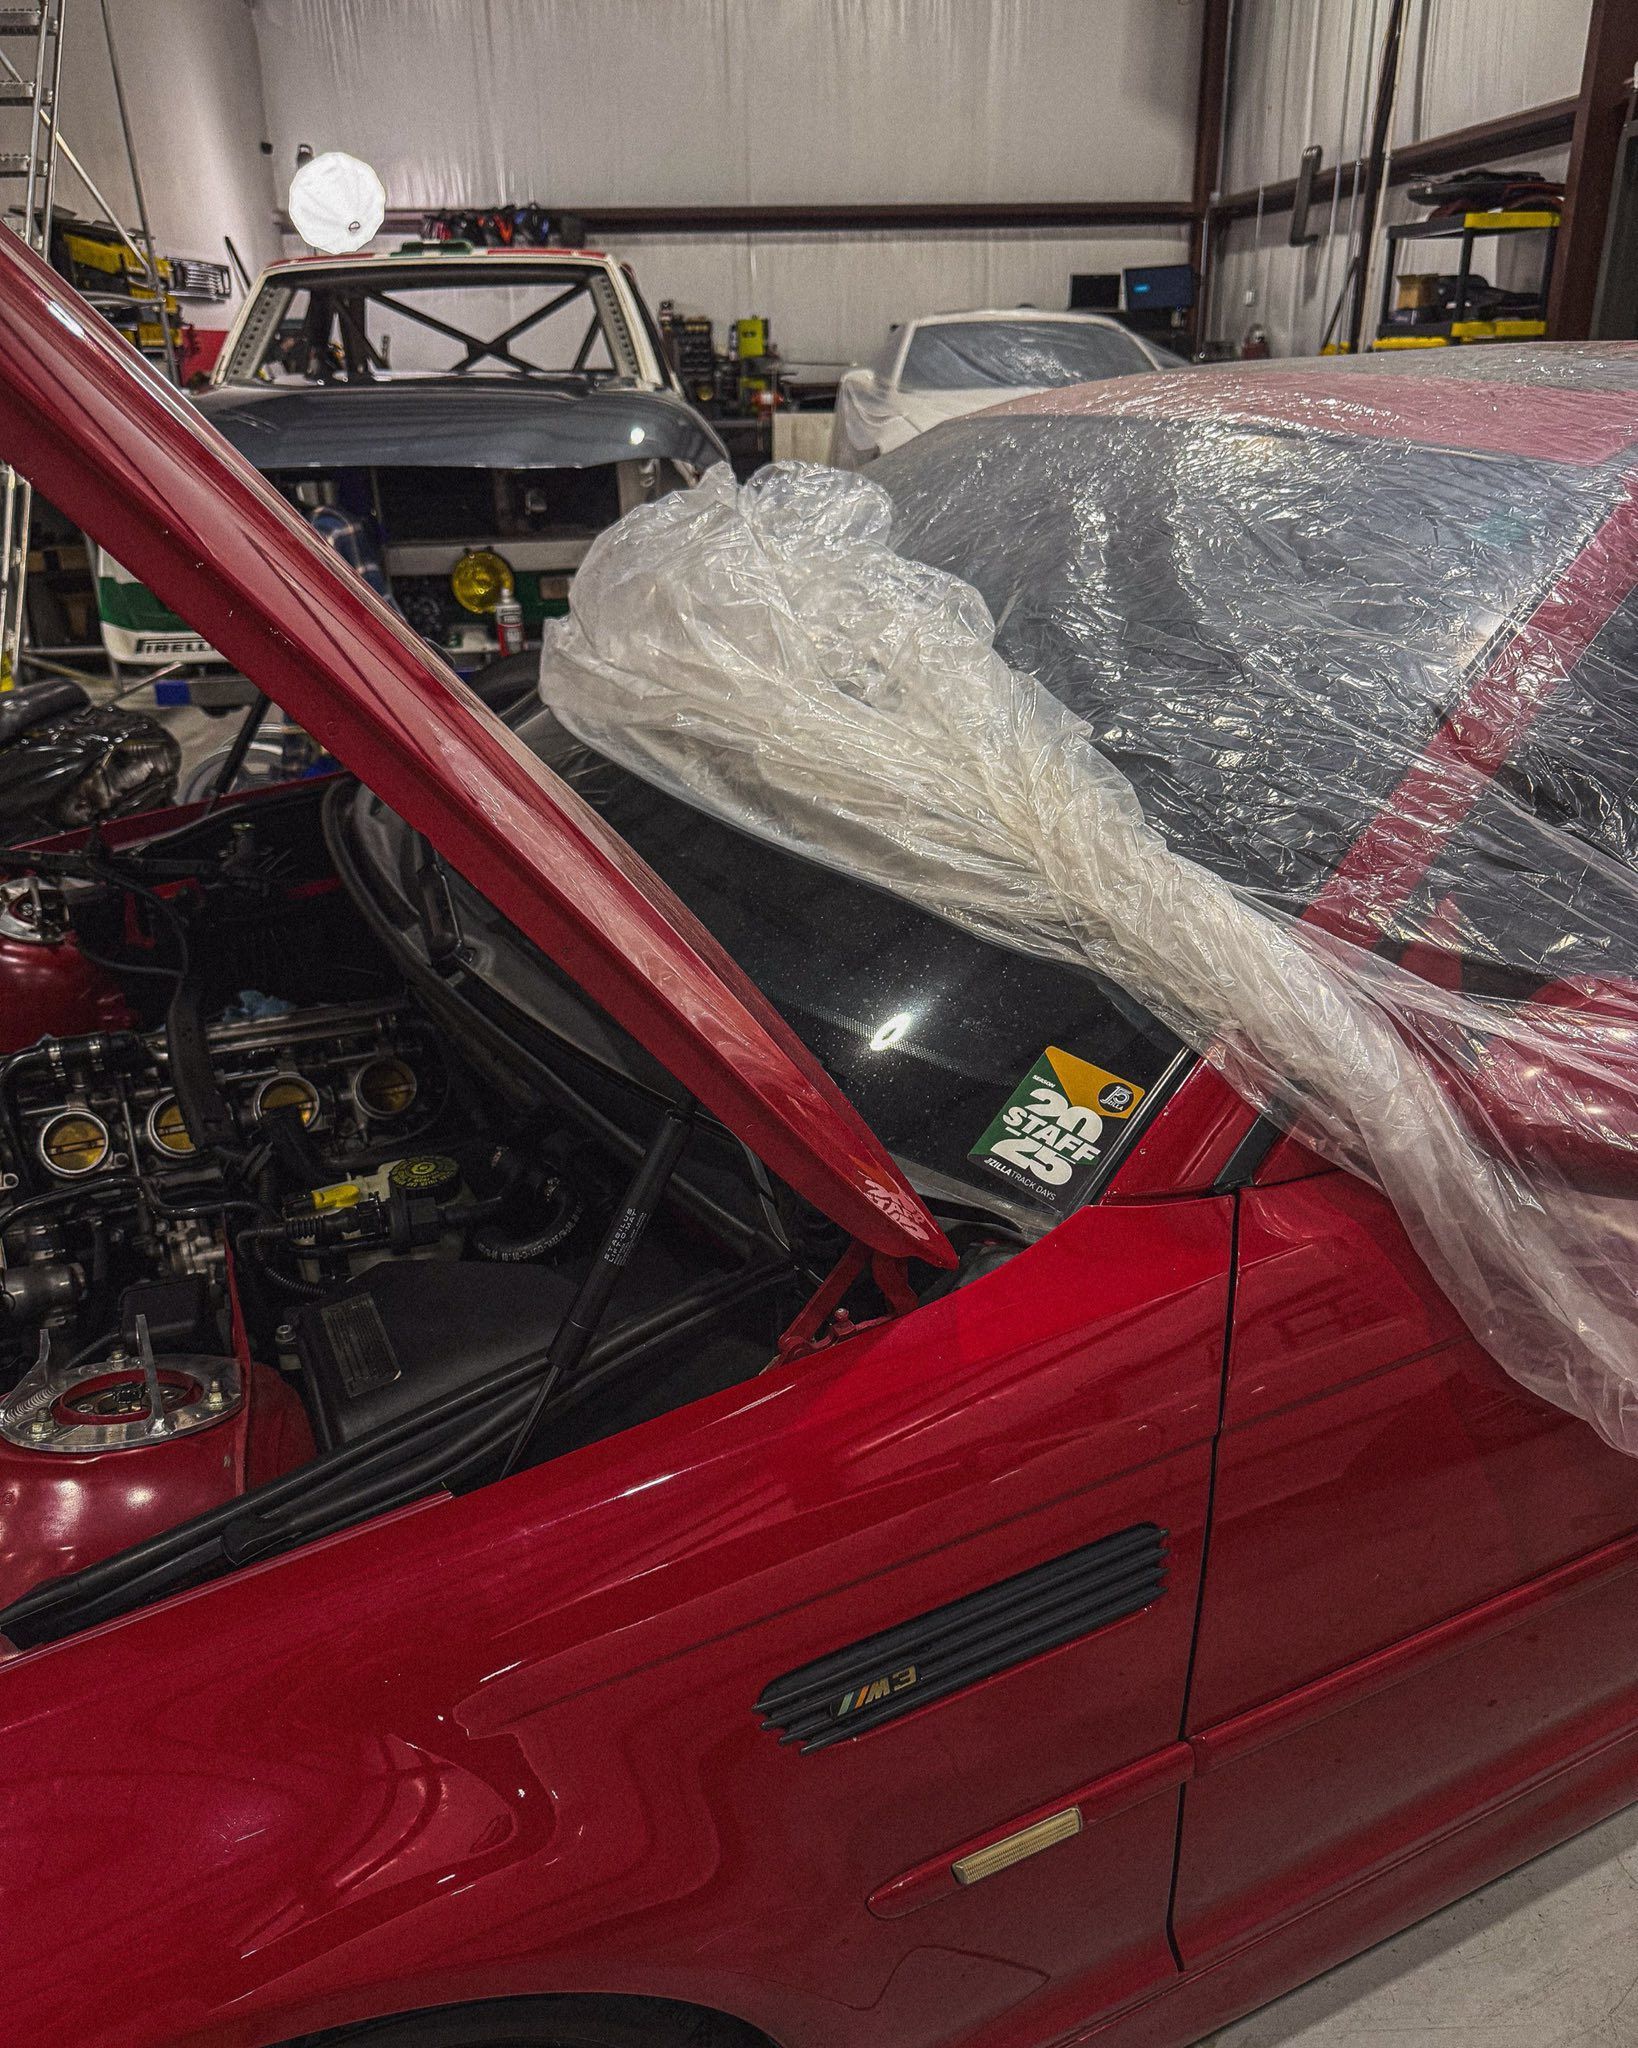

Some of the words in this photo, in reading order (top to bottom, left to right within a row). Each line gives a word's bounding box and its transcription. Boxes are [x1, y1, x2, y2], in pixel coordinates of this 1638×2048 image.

[1032, 1075, 1056, 1088] SEASON
[1002, 1106, 1101, 1162] STAFF
[1024, 1088, 1103, 1144] 20
[990, 1138, 1073, 1185] 25
[1035, 1185, 1057, 1201] DAYS
[865, 1664, 917, 1704] M3
